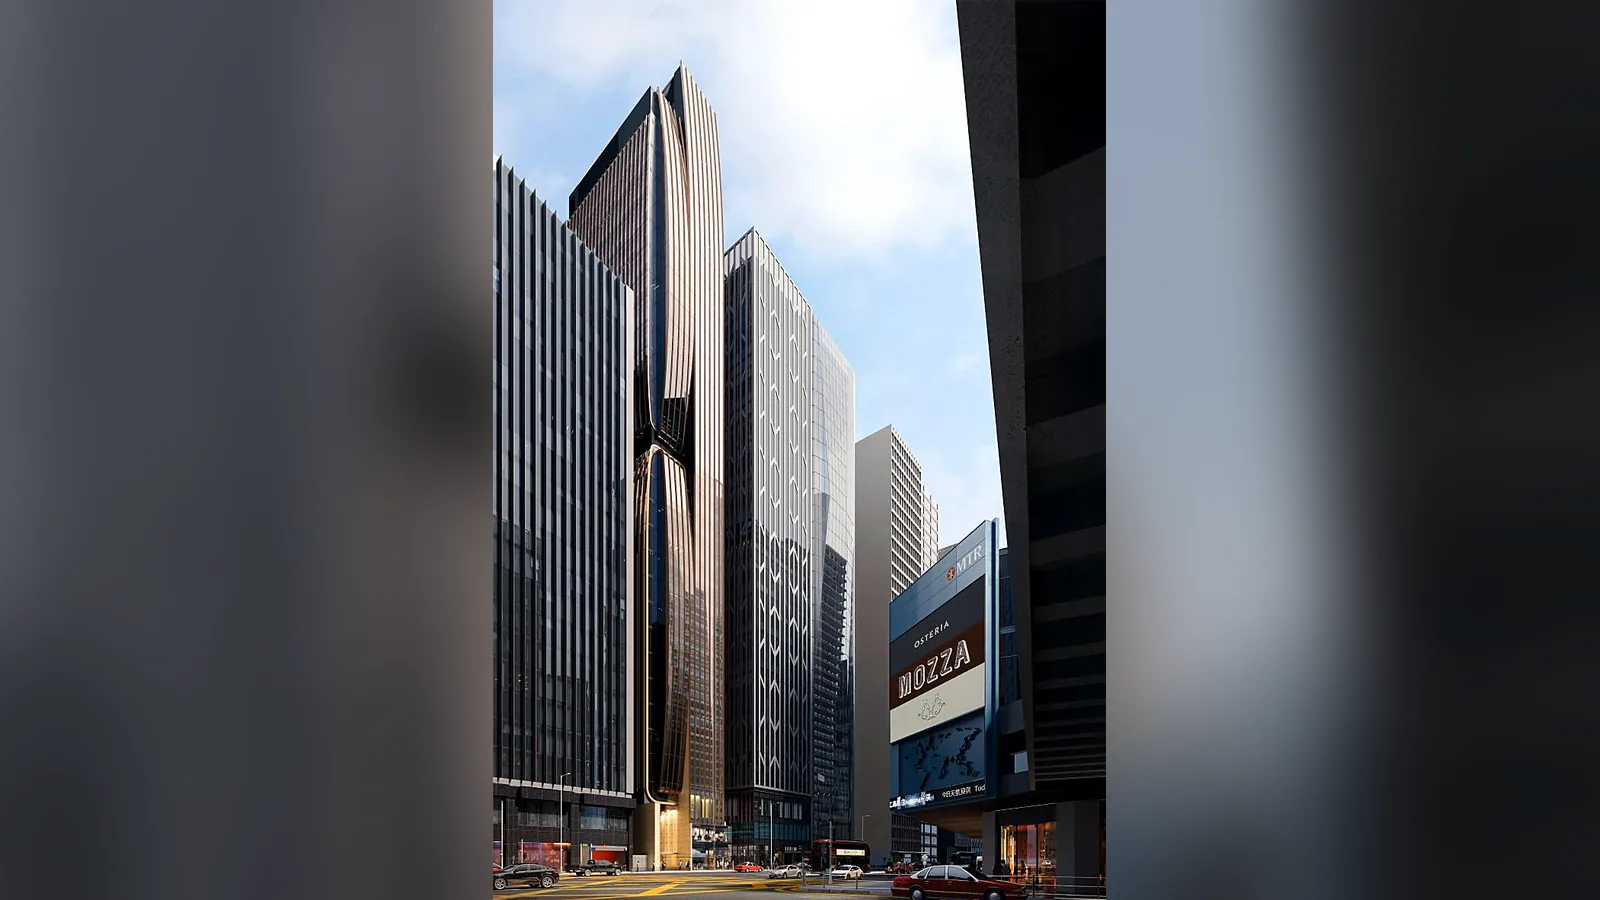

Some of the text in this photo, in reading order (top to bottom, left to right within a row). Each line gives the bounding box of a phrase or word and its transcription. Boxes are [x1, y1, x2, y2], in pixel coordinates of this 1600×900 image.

[957, 546, 982, 571] MTR
[914, 620, 950, 648] OSTERIA
[898, 639, 971, 699] MOZZA
